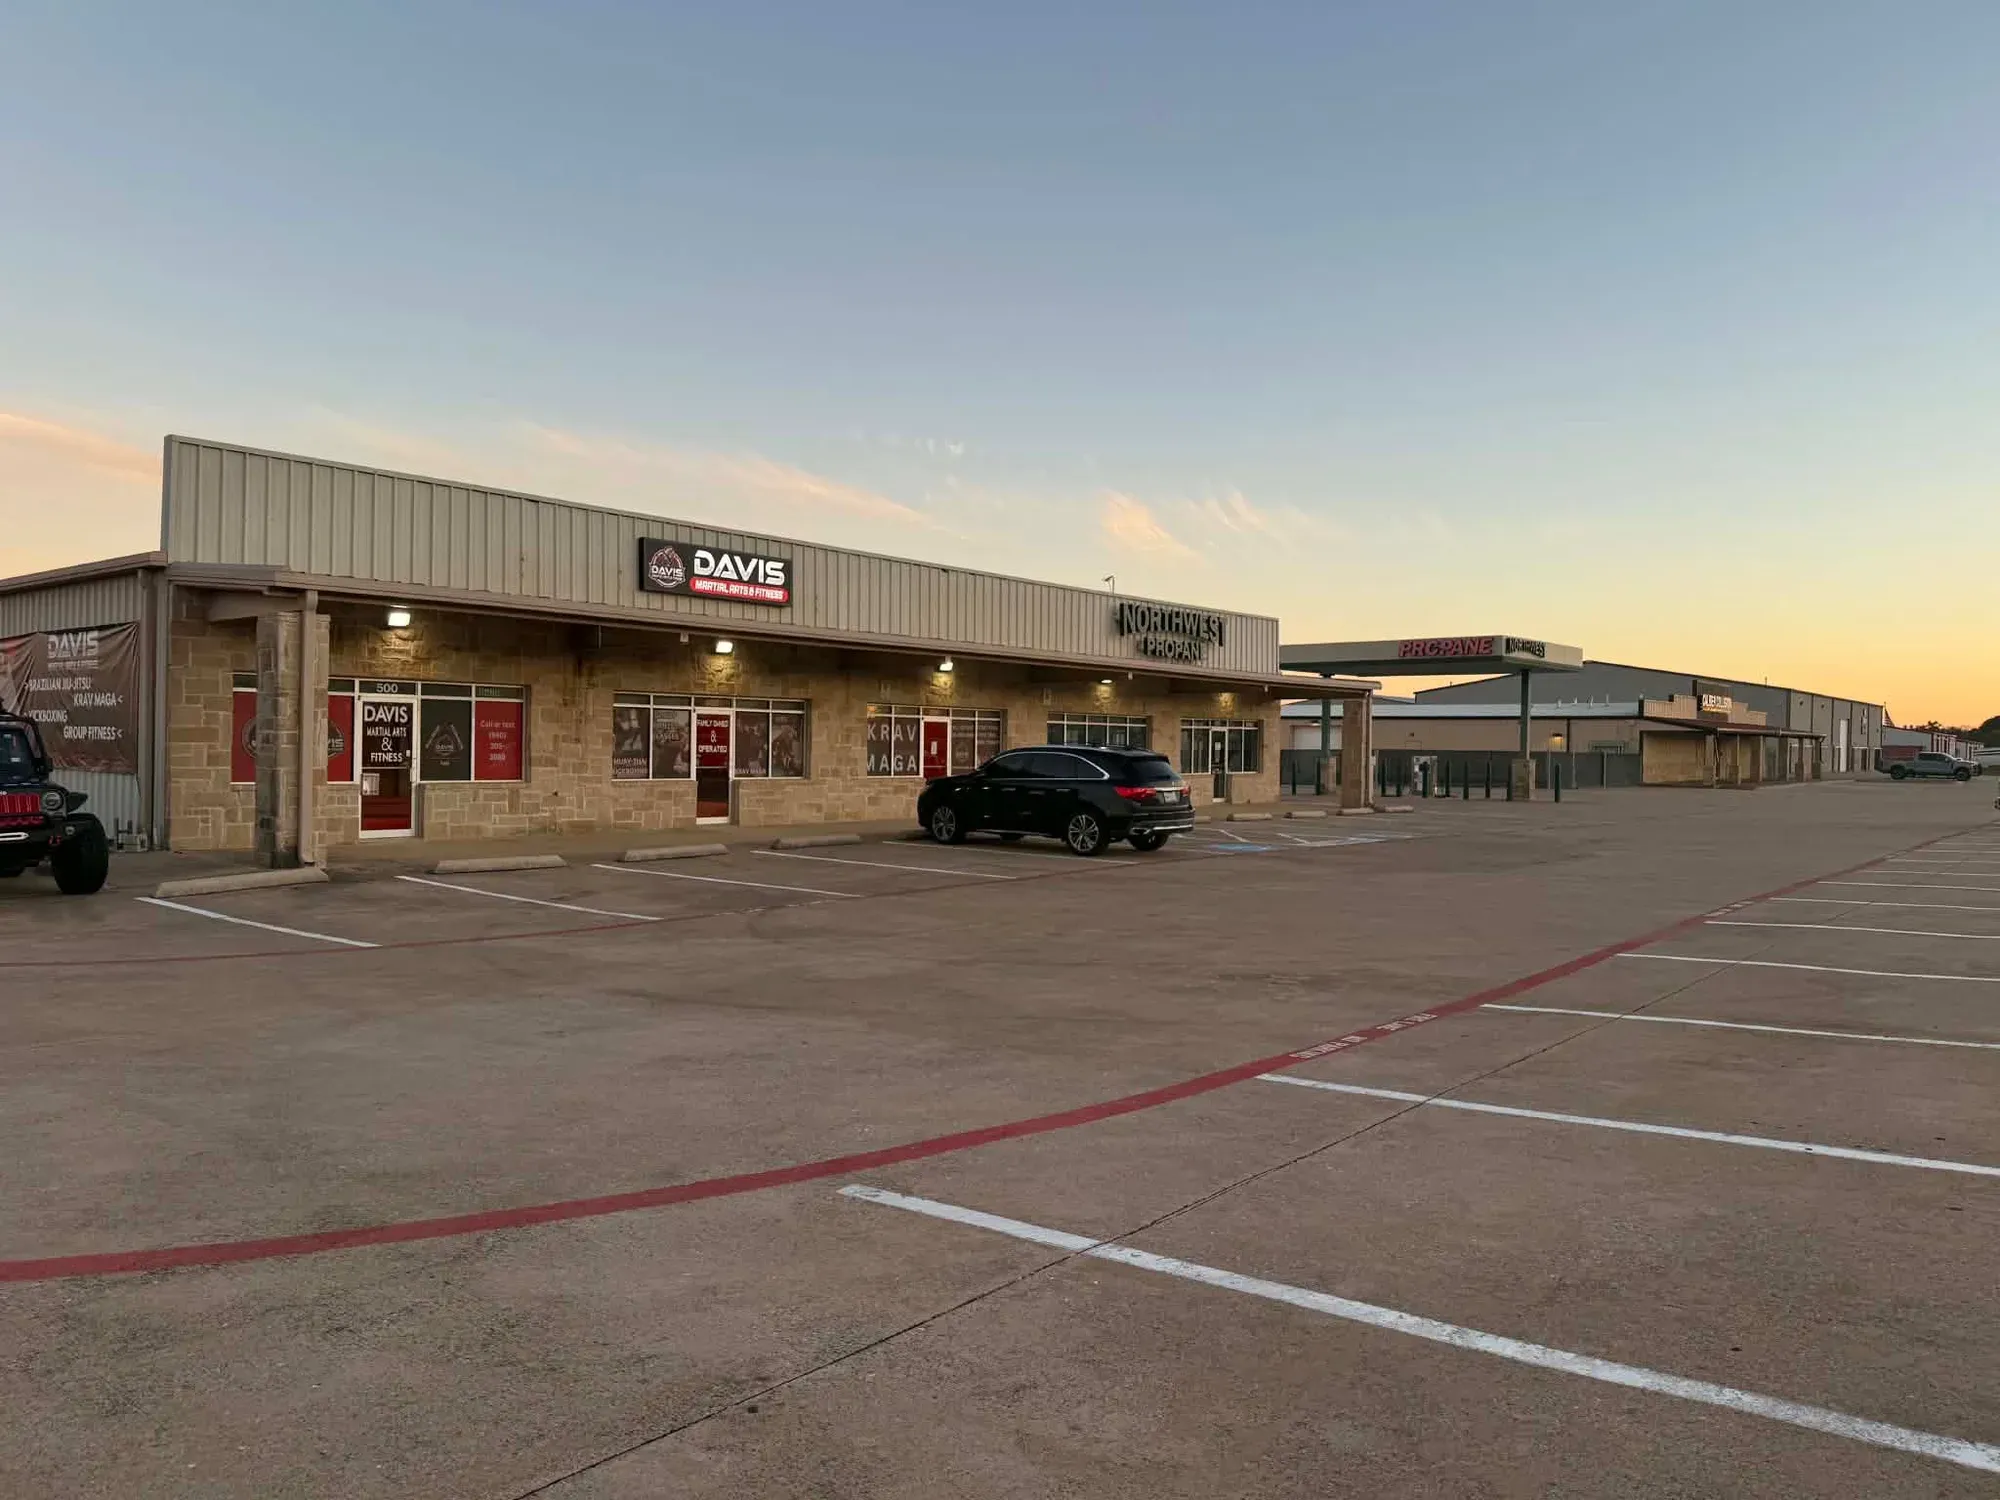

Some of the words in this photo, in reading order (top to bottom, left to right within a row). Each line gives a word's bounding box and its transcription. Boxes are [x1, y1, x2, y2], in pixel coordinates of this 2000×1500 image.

[651, 565, 683, 578] DAVIS
[694, 550, 785, 586] DAVIS
[694, 580, 728, 593] MARTIAL
[729, 585, 748, 595] ARTS
[755, 588, 784, 600] FITNESS
[47, 632, 99, 659] DAVIS
[1398, 638, 1493, 657] PROPANE
[28, 679, 60, 692] BRAZILIAN
[376, 683, 398, 693] 500
[73, 694, 93, 707] KRAV
[94, 693, 117, 706] MAGA
[364, 705, 408, 723] DAVIS
[63, 726, 88, 739] GROUP
[88, 726, 117, 740] FITNESS
[366, 726, 391, 736] MARTIAL
[392, 727, 407, 737] ARTS
[867, 724, 917, 743] KRAV
[381, 737, 393, 751] &
[698, 745, 728, 753] OPERATED
[370, 752, 402, 762] FITNESS
[867, 754, 918, 773] MAGA
